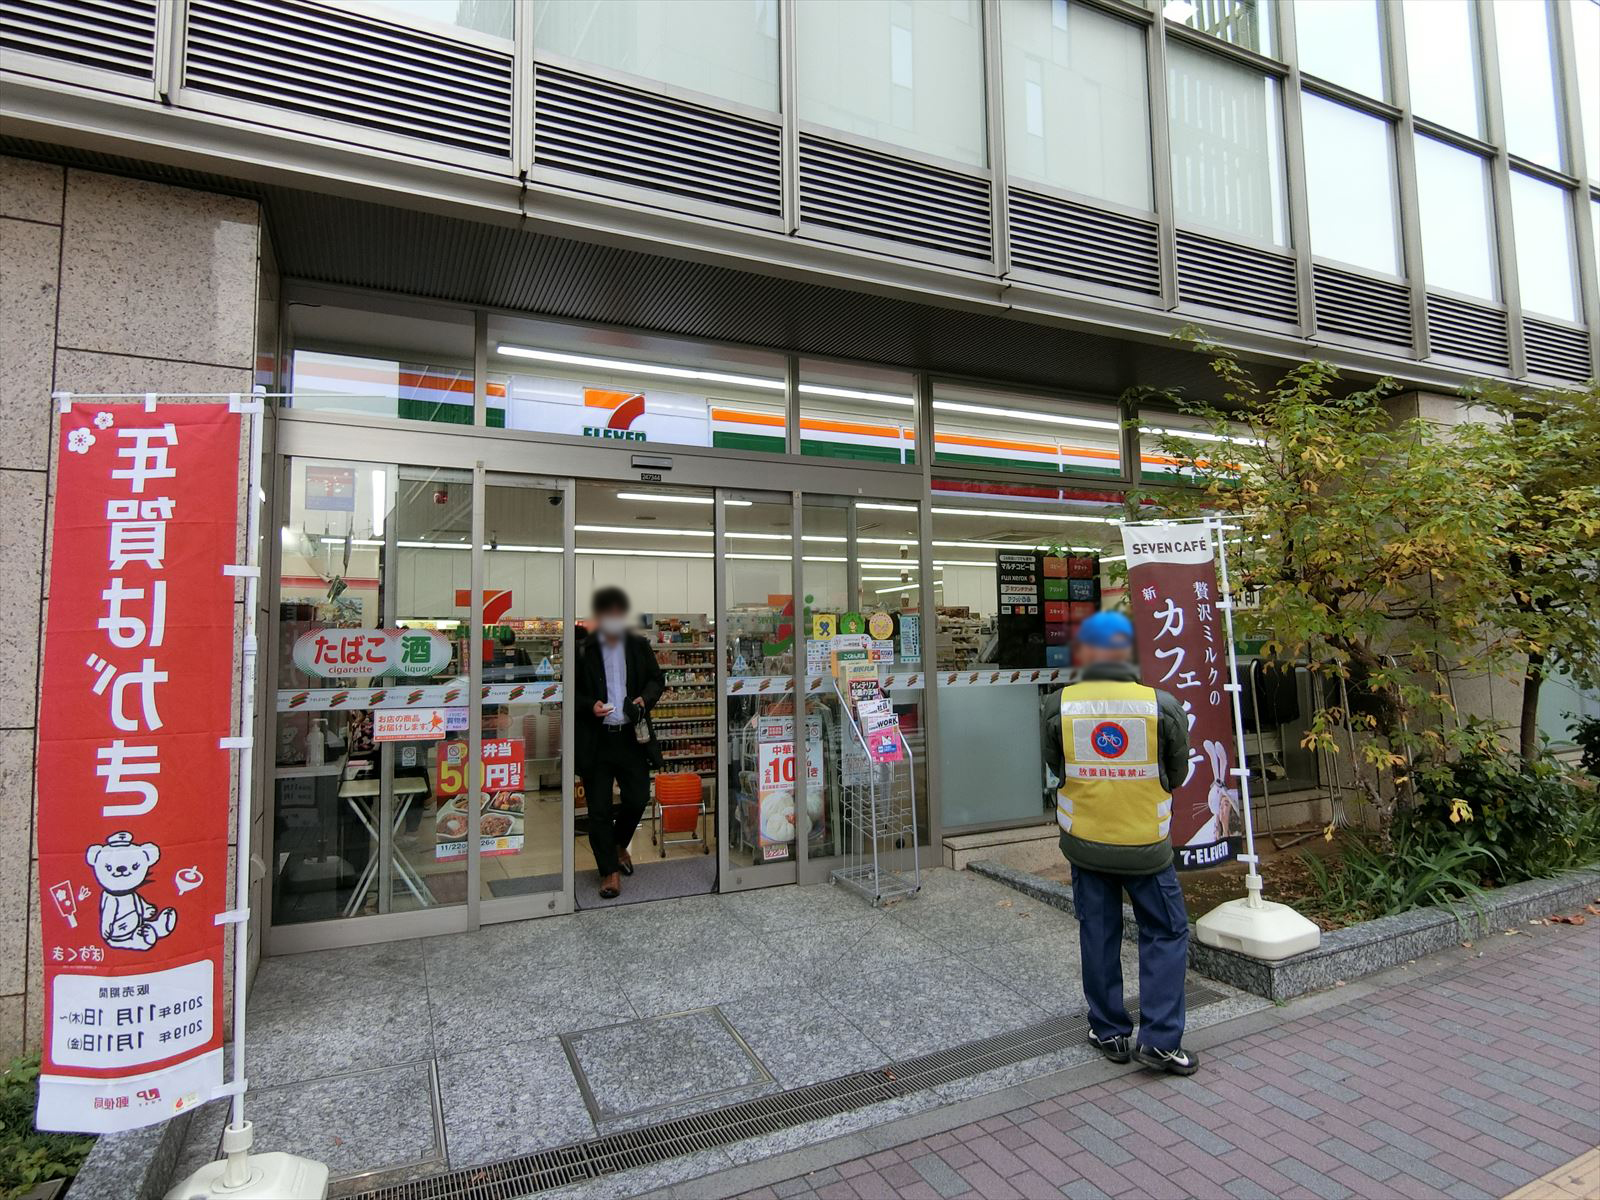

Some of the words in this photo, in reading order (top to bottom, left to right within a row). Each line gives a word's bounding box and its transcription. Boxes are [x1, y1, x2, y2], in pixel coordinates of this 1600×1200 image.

[1132, 544, 1173, 555] SEVEN
[1141, 586, 1157, 601] 新
[1193, 581, 1222, 706] 贅沢ミルクの
[314, 634, 387, 665] たばこ
[401, 636, 432, 664] 酒
[328, 665, 373, 674] cigarette
[404, 665, 432, 673] liquor
[378, 715, 420, 723] お店の商品
[1079, 767, 1147, 778] 放置自転車禁止
